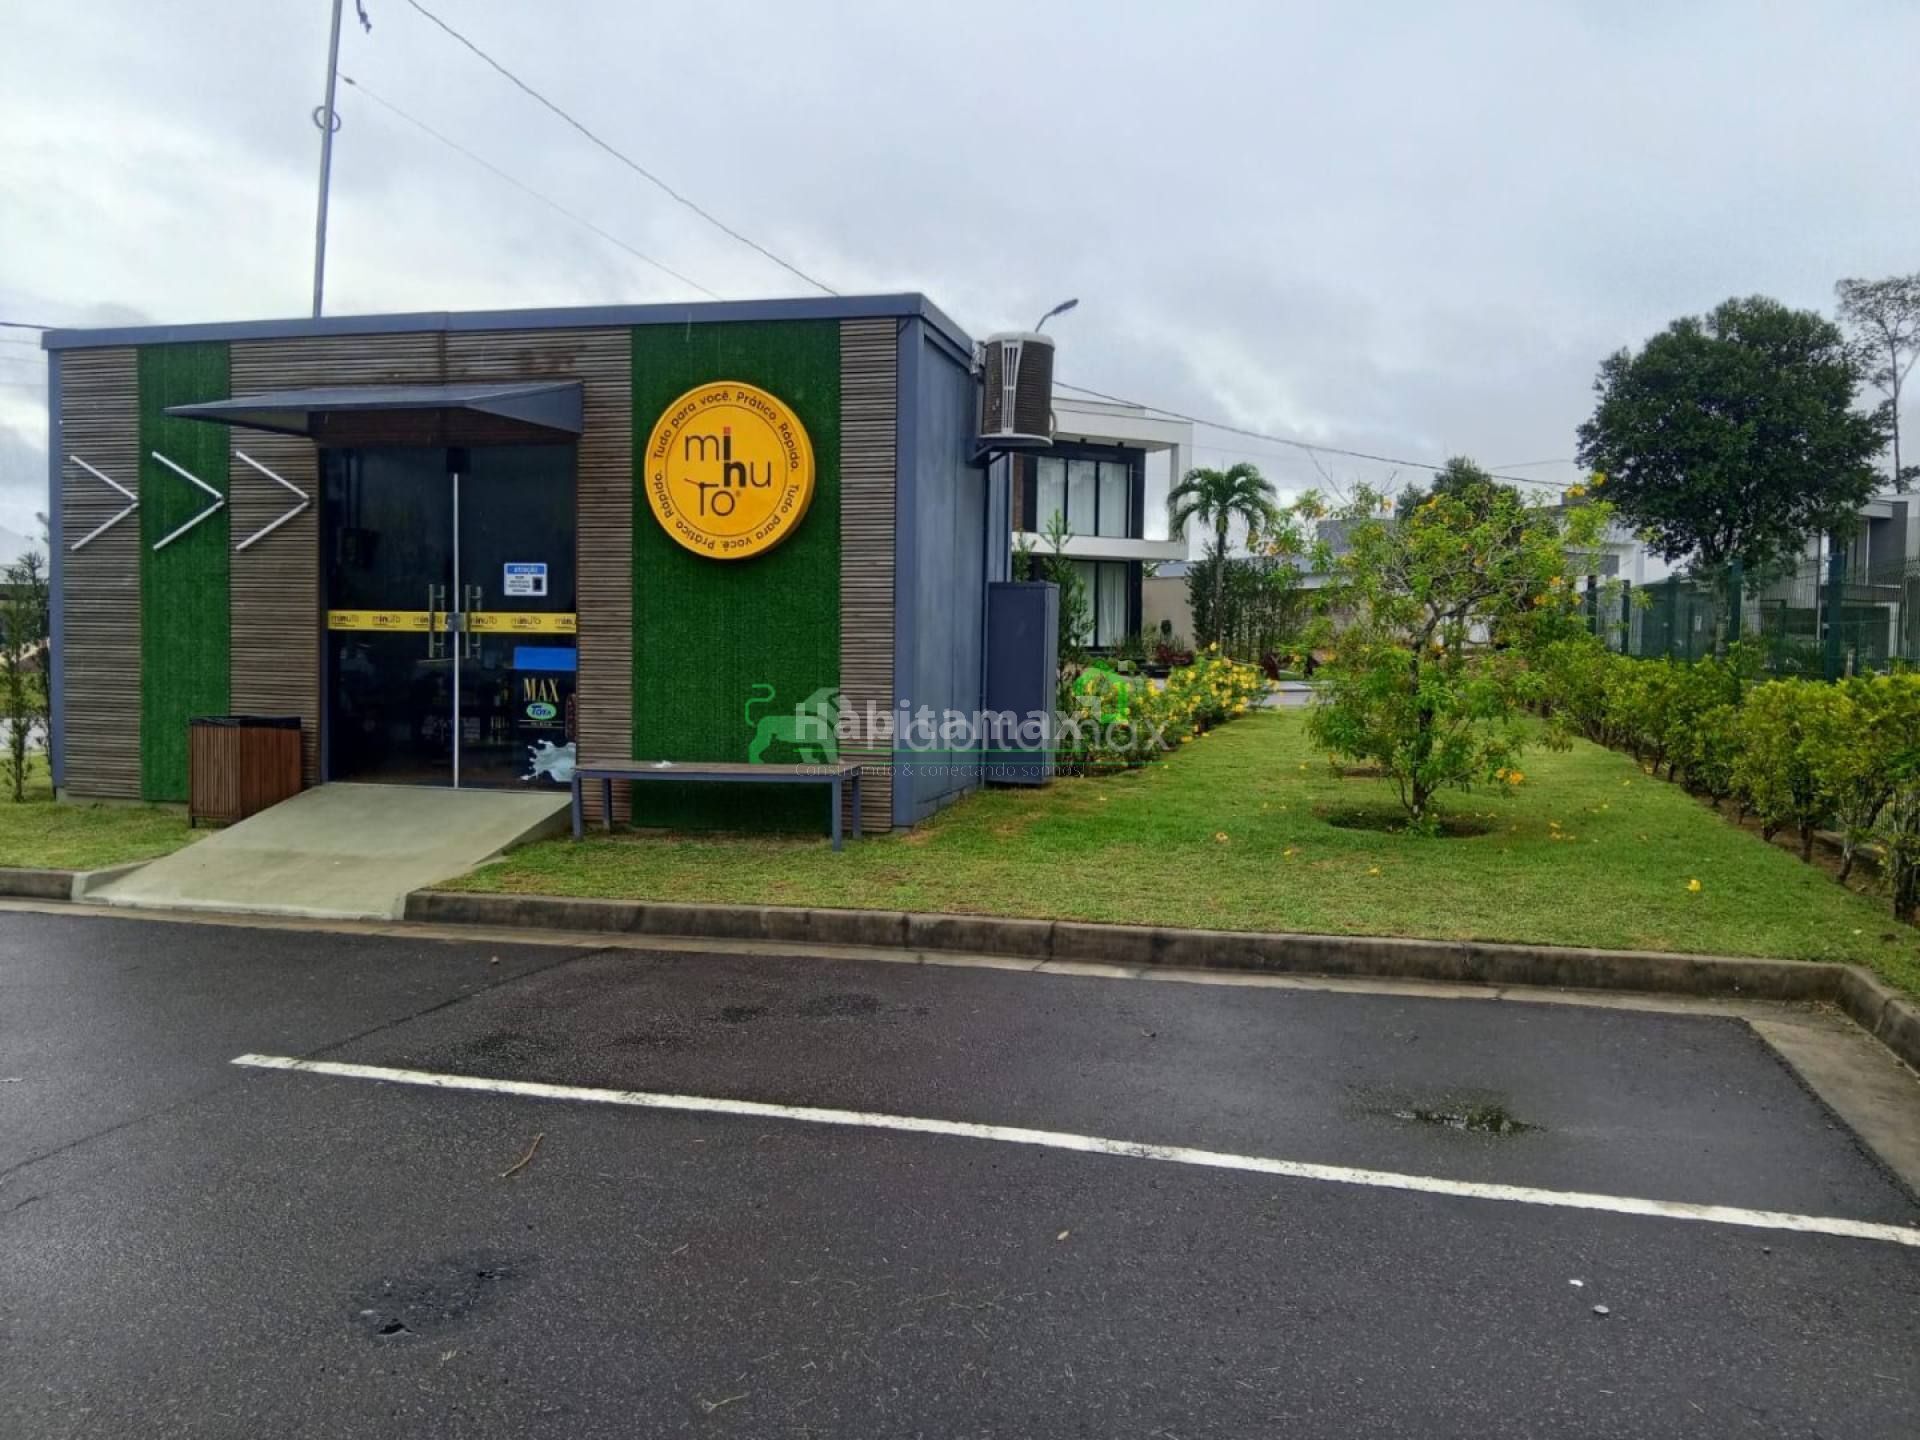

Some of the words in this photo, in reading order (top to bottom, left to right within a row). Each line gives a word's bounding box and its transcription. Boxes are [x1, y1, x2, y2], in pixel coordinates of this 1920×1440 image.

[653, 429, 672, 460] Tudo
[671, 402, 697, 428] para
[781, 485, 800, 514] Tudo
[755, 515, 781, 540] para
[523, 678, 559, 702] MAX
